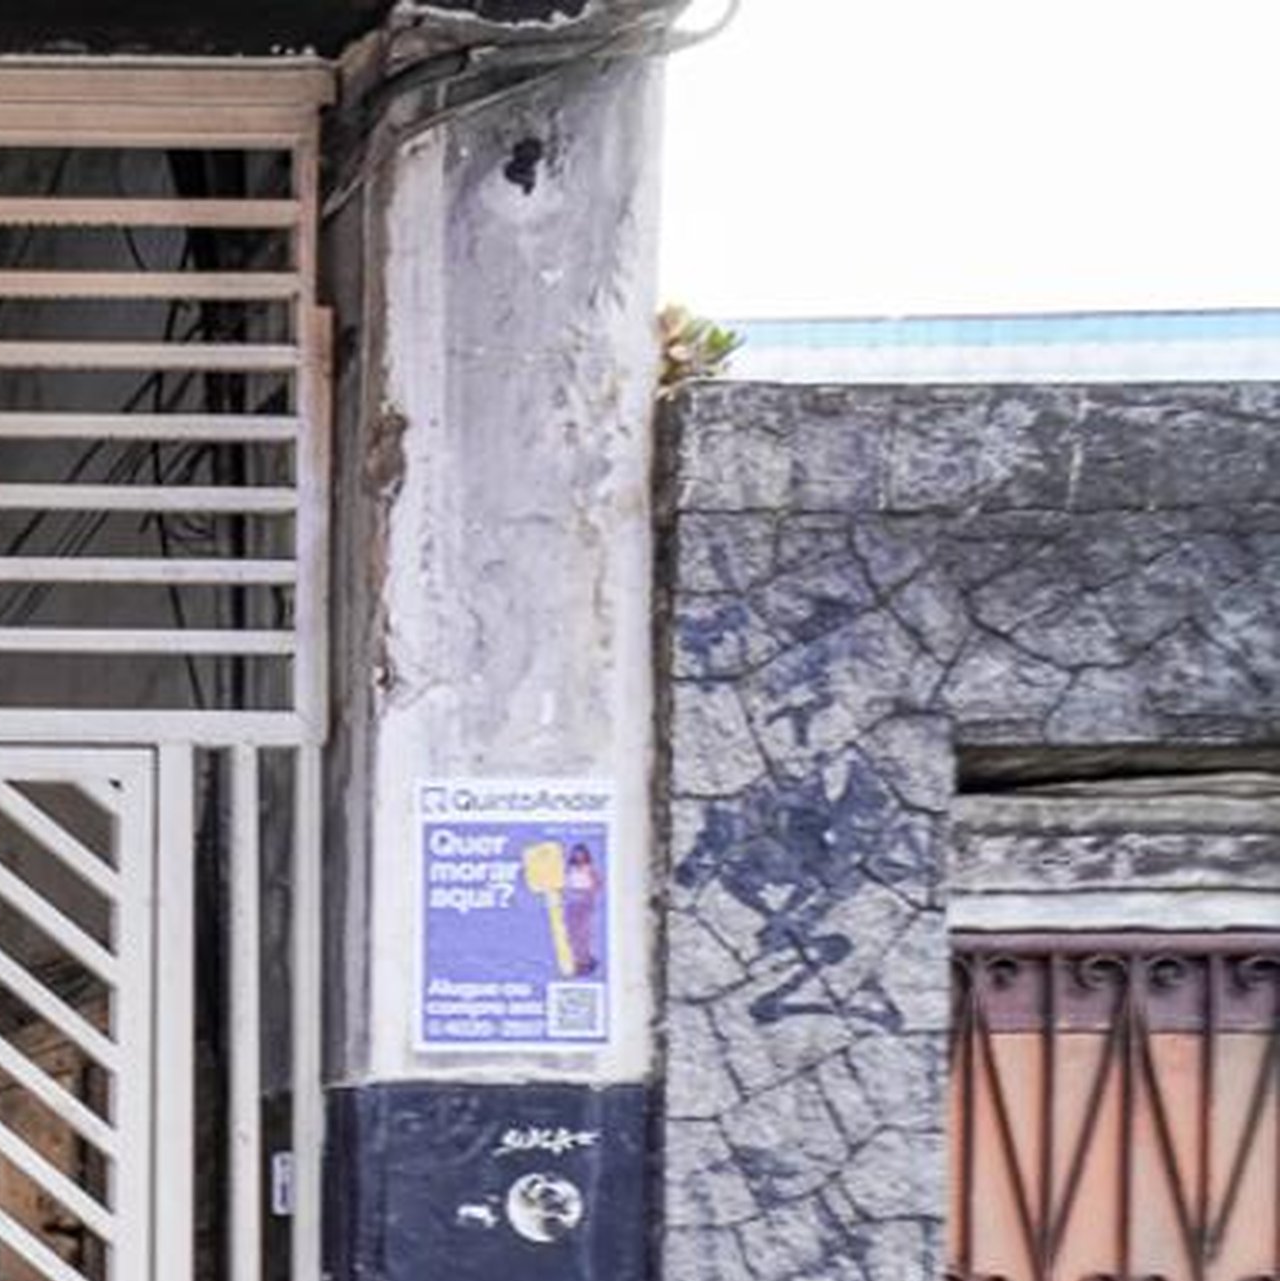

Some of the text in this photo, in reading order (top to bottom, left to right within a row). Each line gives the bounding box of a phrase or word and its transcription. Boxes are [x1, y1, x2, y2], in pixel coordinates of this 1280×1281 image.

[453, 788, 611, 813] QuintoAndar
[429, 829, 508, 857] Quer
[429, 860, 521, 884] morar
[429, 884, 515, 913] aqui?
